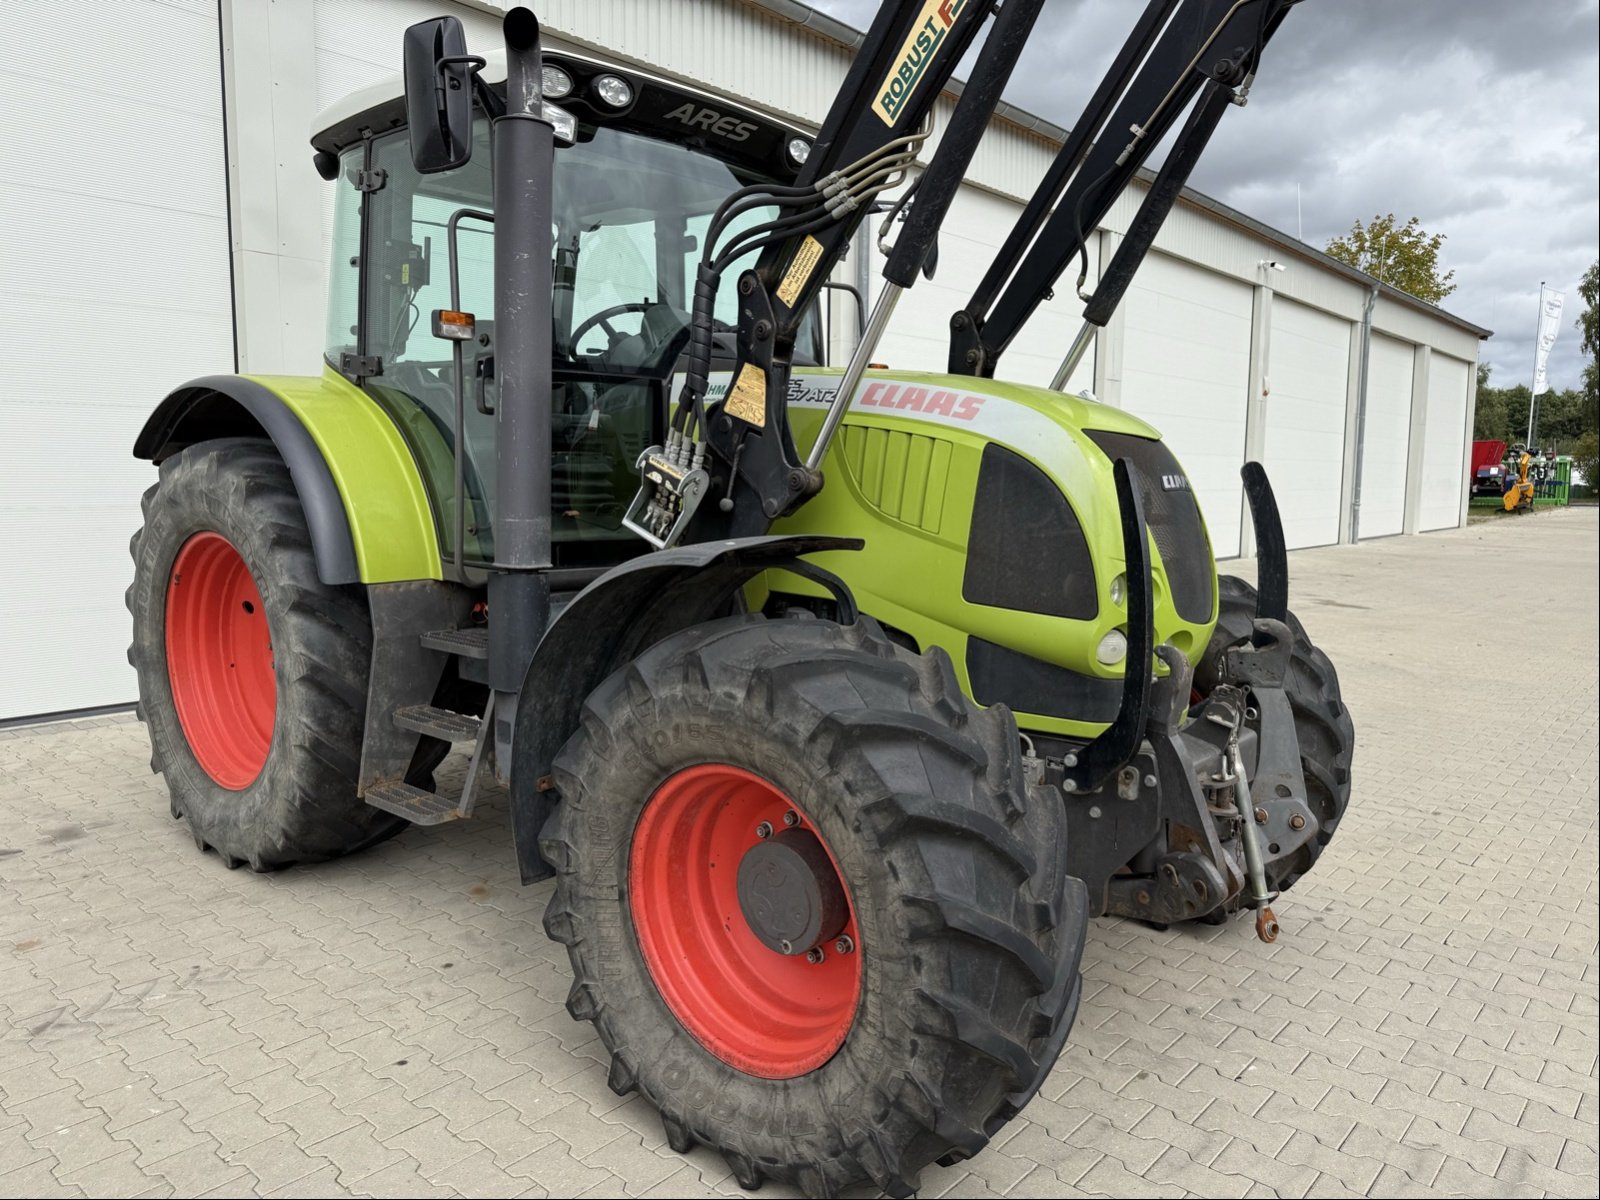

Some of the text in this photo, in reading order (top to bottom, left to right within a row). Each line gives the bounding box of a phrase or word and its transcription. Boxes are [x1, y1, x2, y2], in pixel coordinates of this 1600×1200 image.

[880, 15, 939, 115] ROBUST
[663, 103, 760, 142] ARES
[860, 383, 986, 421] CLAAS
